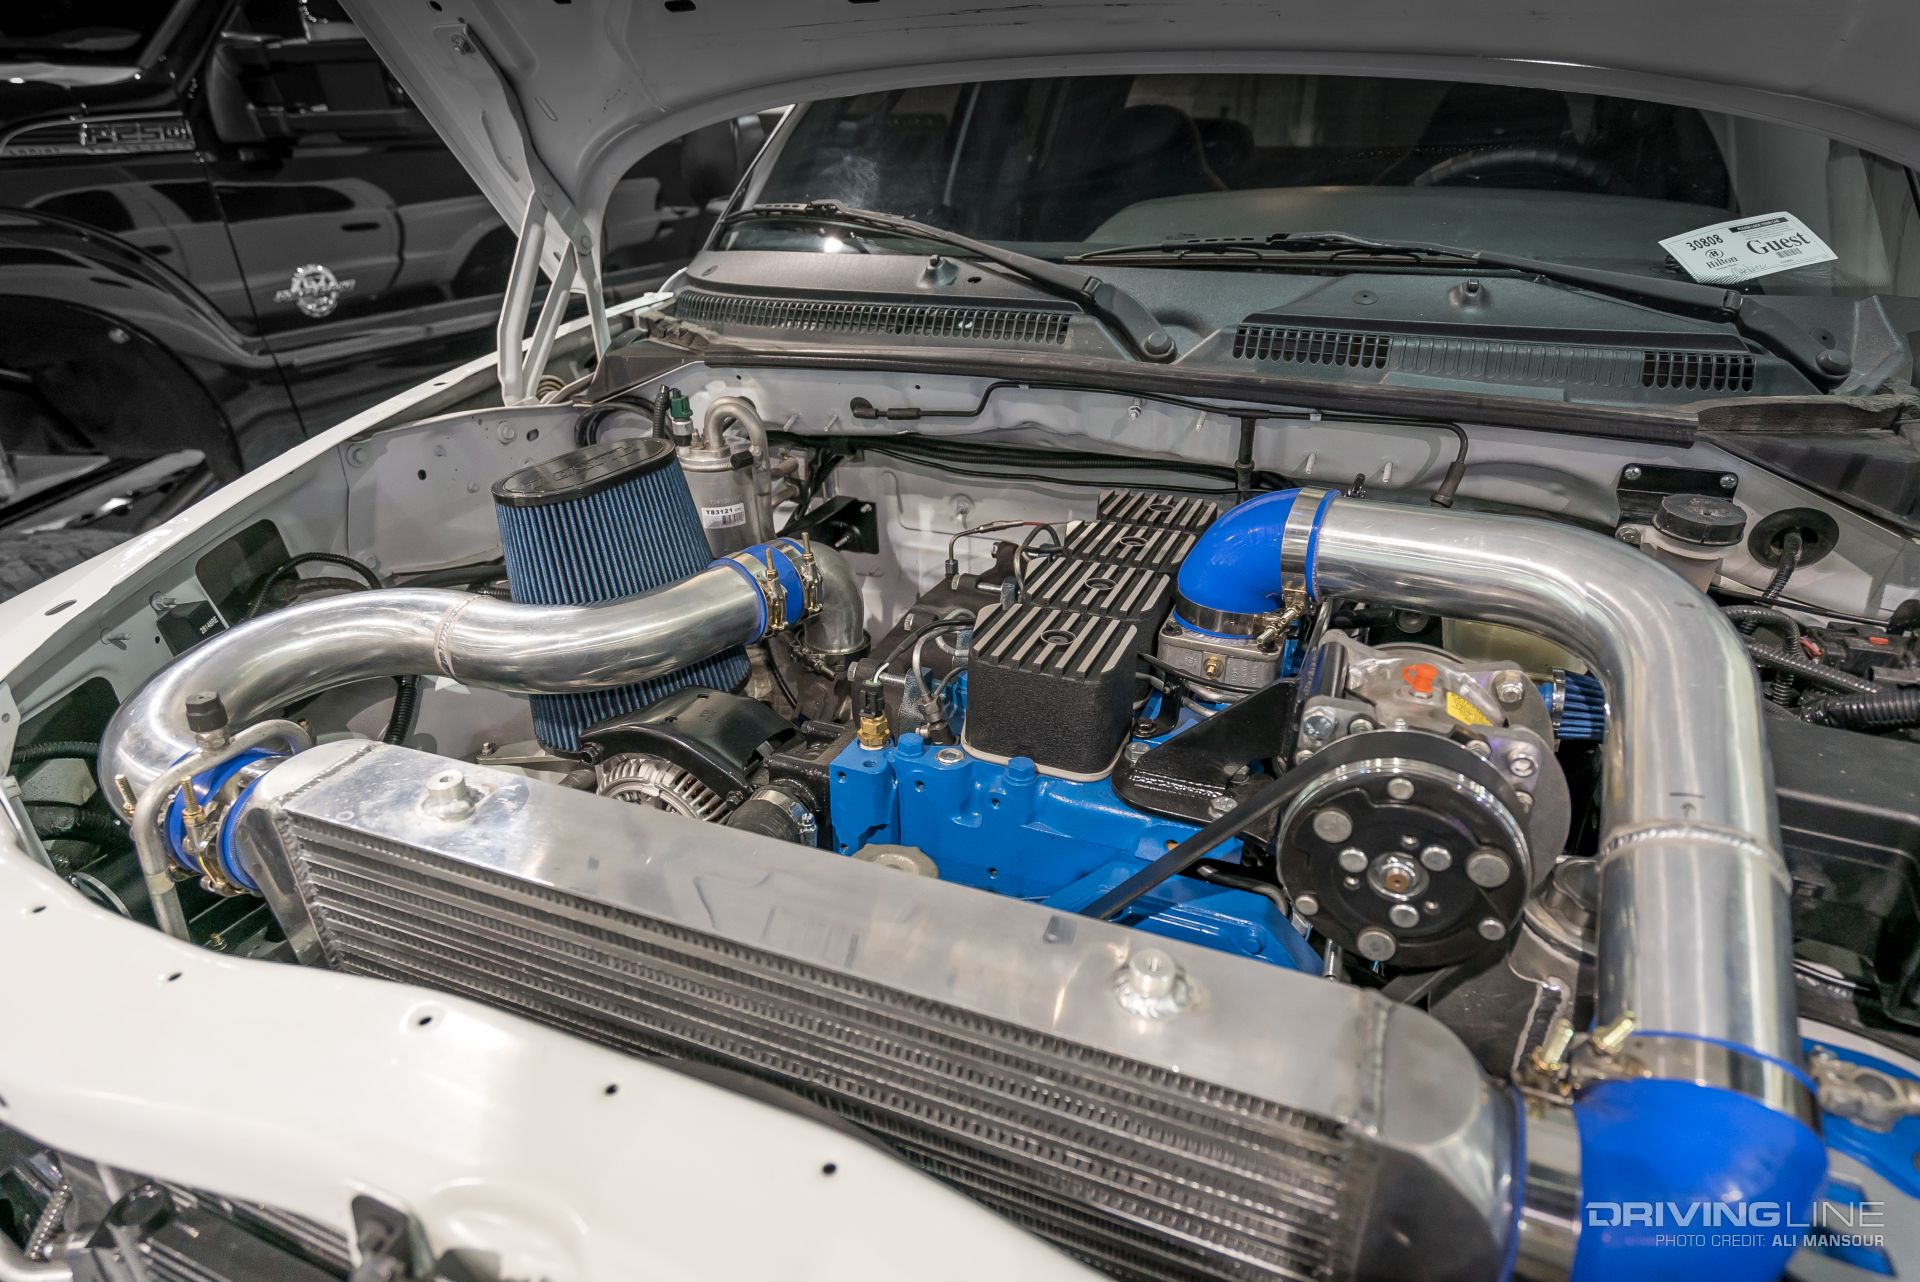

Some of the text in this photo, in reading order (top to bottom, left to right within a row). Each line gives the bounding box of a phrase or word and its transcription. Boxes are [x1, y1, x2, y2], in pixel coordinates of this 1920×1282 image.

[1686, 234, 1724, 251] 30808
[1746, 232, 1811, 255] Guest
[1706, 256, 1738, 269] Hilton
